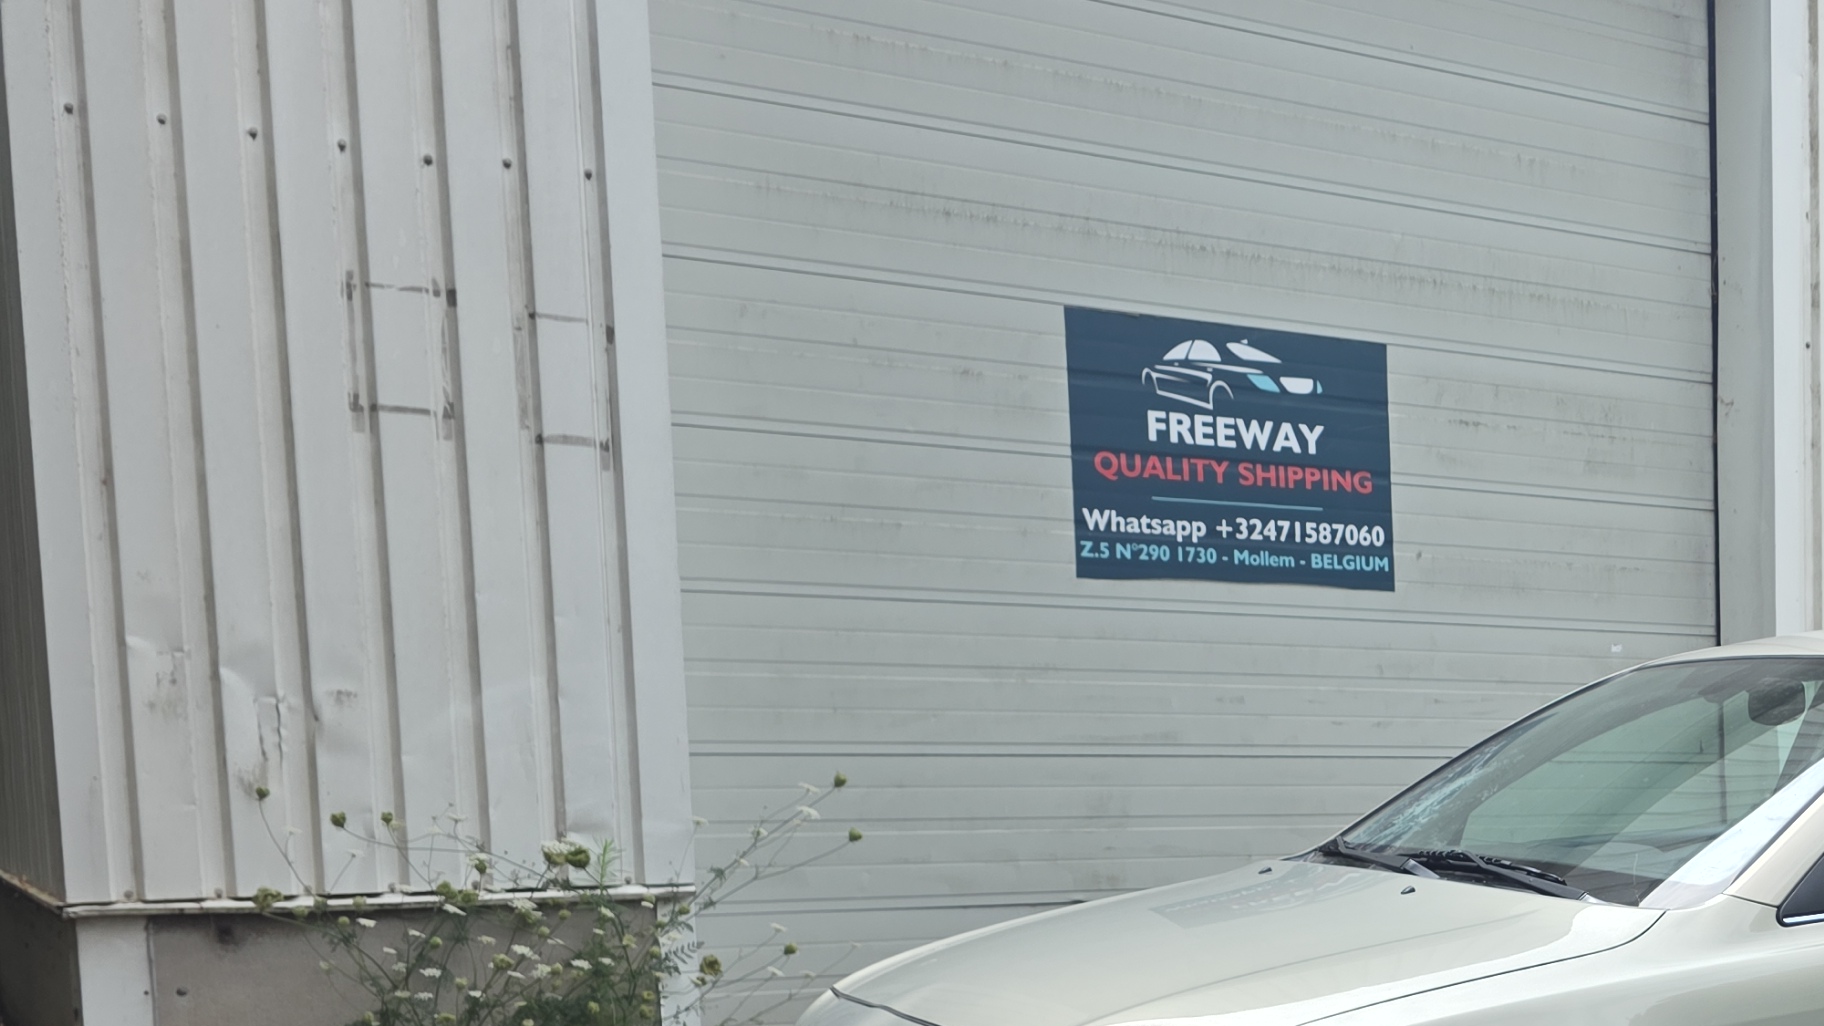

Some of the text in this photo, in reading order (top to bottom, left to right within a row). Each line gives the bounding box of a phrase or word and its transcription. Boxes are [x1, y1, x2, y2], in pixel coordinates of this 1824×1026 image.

[1147, 409, 1325, 455] FREEWAY
[1094, 450, 1373, 495] QUALITY SHIPPING
[1082, 507, 1385, 547] Whatsapp +32471587060
[1177, 545, 1217, 564] 1730
[1233, 549, 1295, 568] Mollem
[1310, 553, 1390, 572] BELGIUM
